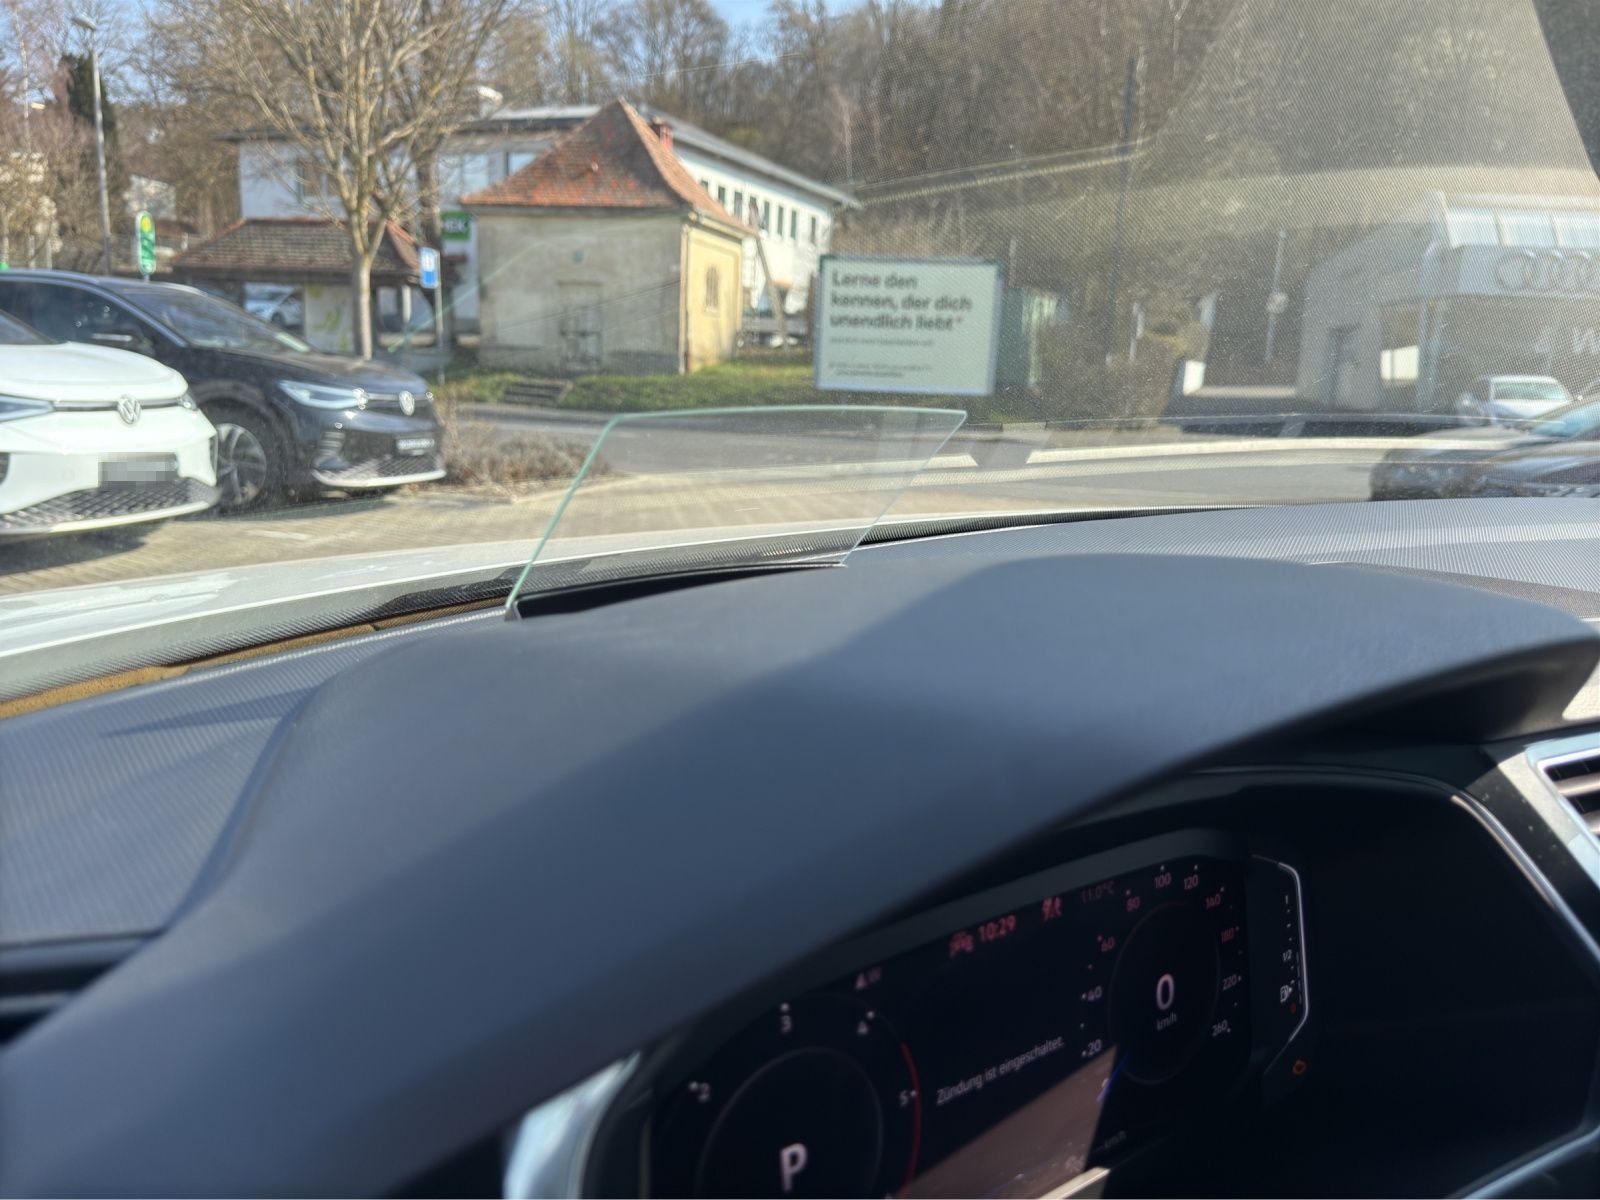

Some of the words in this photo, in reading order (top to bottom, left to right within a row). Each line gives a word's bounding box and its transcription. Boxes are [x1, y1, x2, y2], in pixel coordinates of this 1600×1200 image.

[831, 270, 881, 288] Lerne
[885, 272, 918, 289] den
[830, 293, 897, 311] kennen,
[901, 295, 930, 309] der
[934, 296, 973, 311] dich
[830, 313, 913, 329] unendlich
[1154, 872, 1172, 889] 100
[1184, 875, 1200, 891] 120
[978, 914, 1016, 942] 10:29
[1155, 972, 1176, 1011] 0
[1222, 974, 1237, 991] 220
[1087, 985, 1103, 1002] 40
[780, 1015, 793, 1034] 3
[1155, 1013, 1178, 1032] km/h
[1088, 1039, 1103, 1055] 20
[697, 1082, 712, 1103] 2
[936, 1074, 985, 1107] Zündung
[985, 1066, 998, 1082] ist
[898, 1091, 909, 1108] 5
[779, 1141, 809, 1195] P
